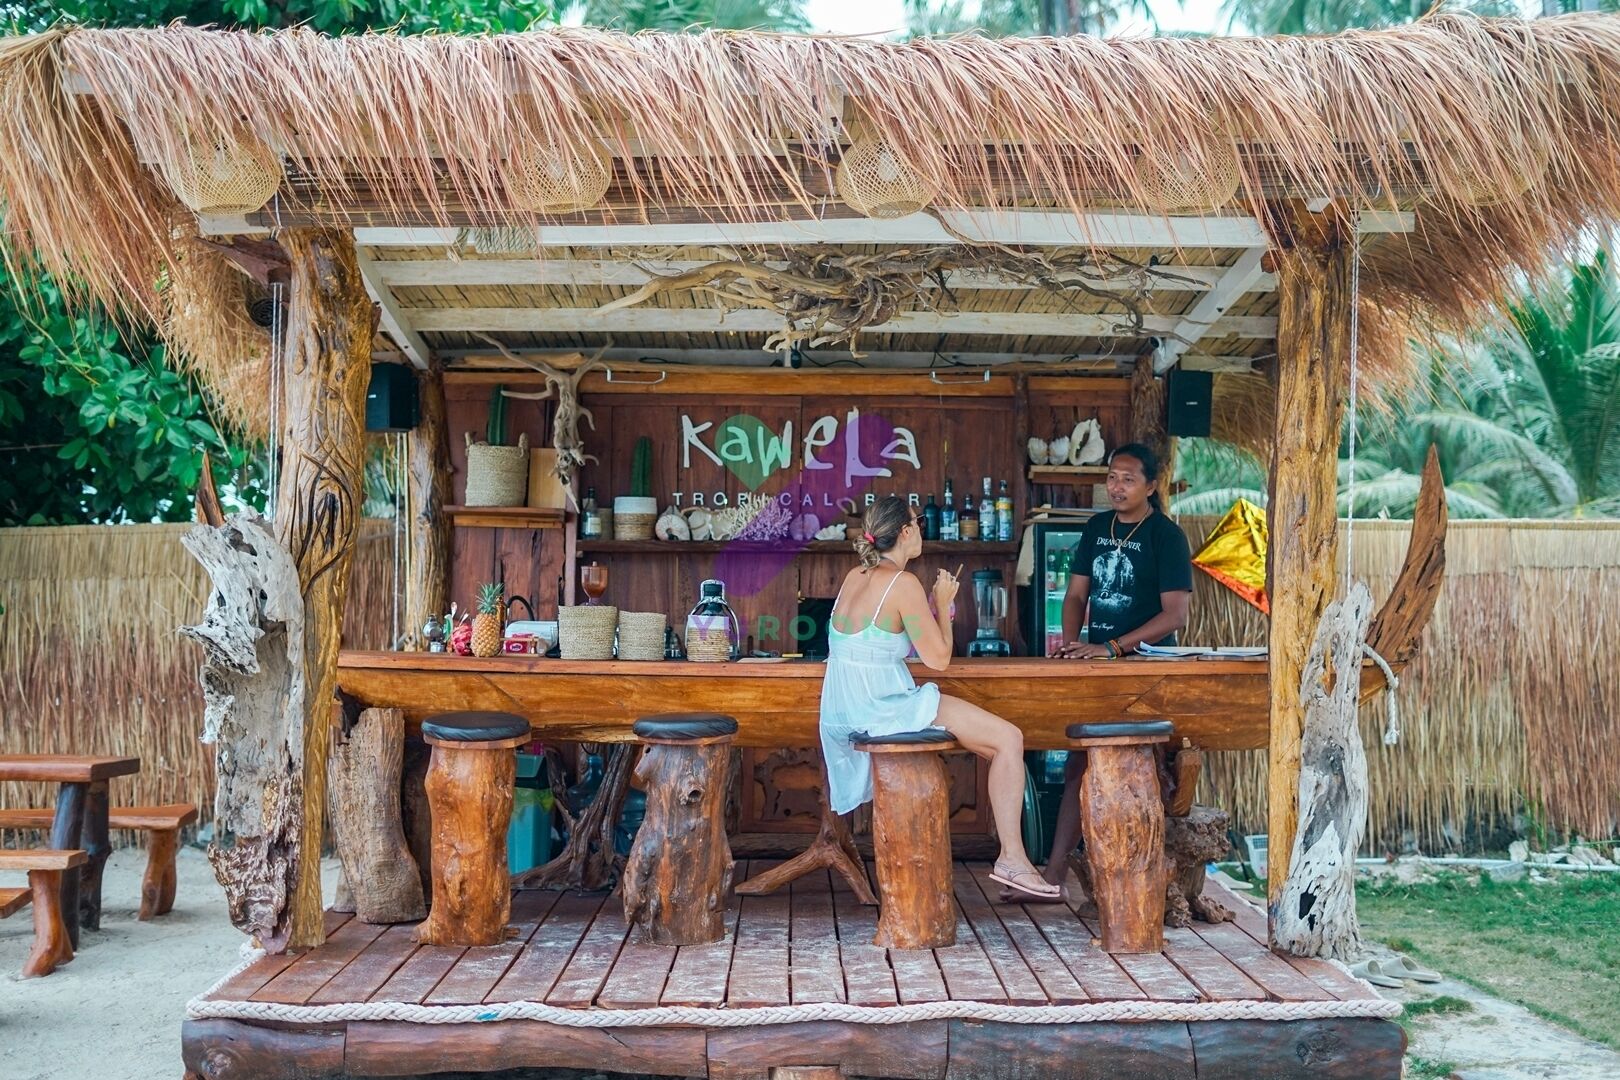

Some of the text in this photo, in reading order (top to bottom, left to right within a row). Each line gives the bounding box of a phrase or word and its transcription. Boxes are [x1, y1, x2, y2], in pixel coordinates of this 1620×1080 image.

[672, 492, 920, 506] TROPCAL BR
[1116, 538, 1142, 552] TEATER
